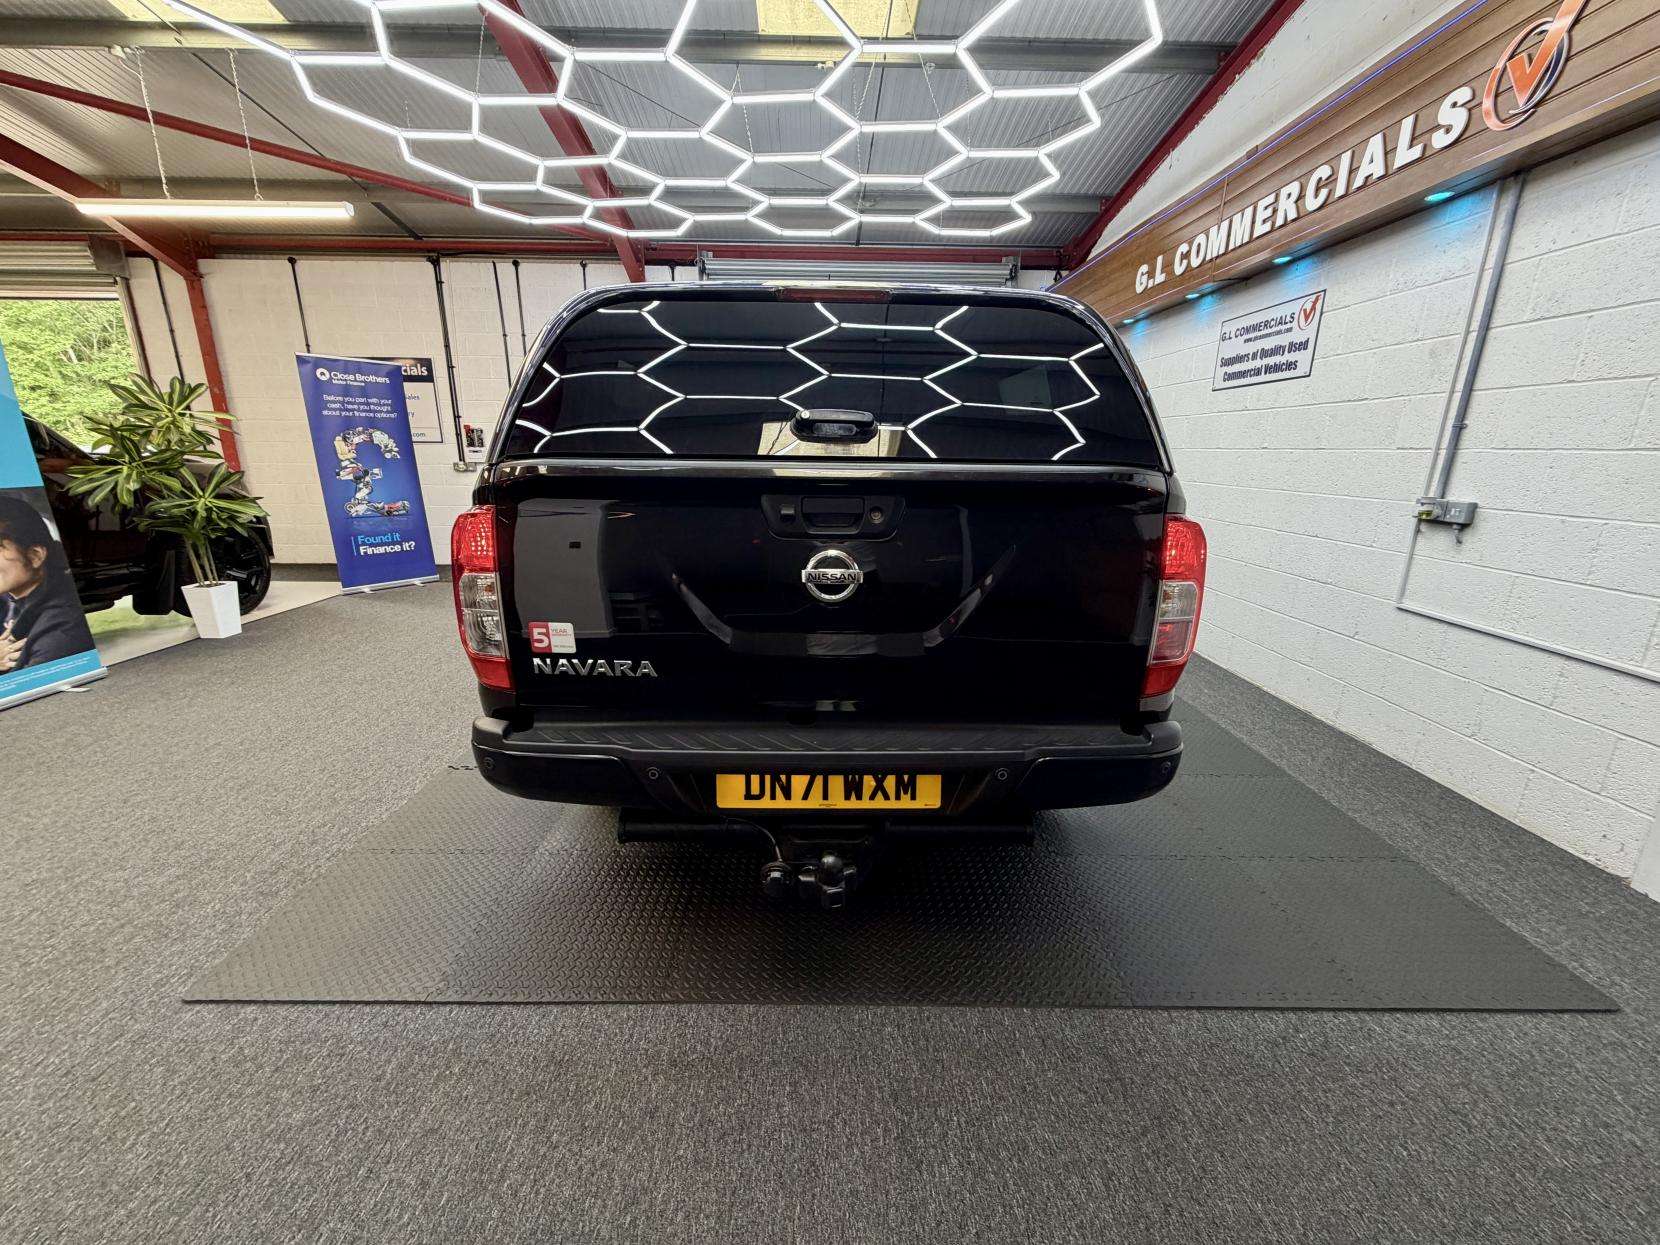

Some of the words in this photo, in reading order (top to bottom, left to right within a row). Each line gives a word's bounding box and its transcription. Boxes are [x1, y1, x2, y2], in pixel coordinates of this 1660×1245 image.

[1135, 255, 1166, 294] G.L
[1173, 86, 1474, 276] COMMERCIALS
[1221, 330, 1233, 342] G.L
[1234, 312, 1296, 338] COMMERCIALS
[1219, 352, 1250, 368] Suppliers
[1251, 348, 1260, 362] of
[1259, 343, 1287, 360] Quality
[1287, 337, 1310, 354] Used
[330, 371, 355, 381] Close
[355, 373, 390, 384] Brothers
[1222, 364, 1264, 383] Commercial
[1263, 359, 1299, 376] Vehicles
[323, 394, 344, 402] Before
[354, 410, 374, 418] finance
[357, 533, 392, 545] Found
[392, 532, 401, 541] it
[359, 545, 402, 556] Finance
[402, 541, 416, 551] it?
[807, 573, 857, 582] NISSAN
[532, 627, 550, 648] 5
[532, 657, 658, 677] NAVARA
[743, 774, 829, 801] DN71
[842, 774, 917, 801] WXM
